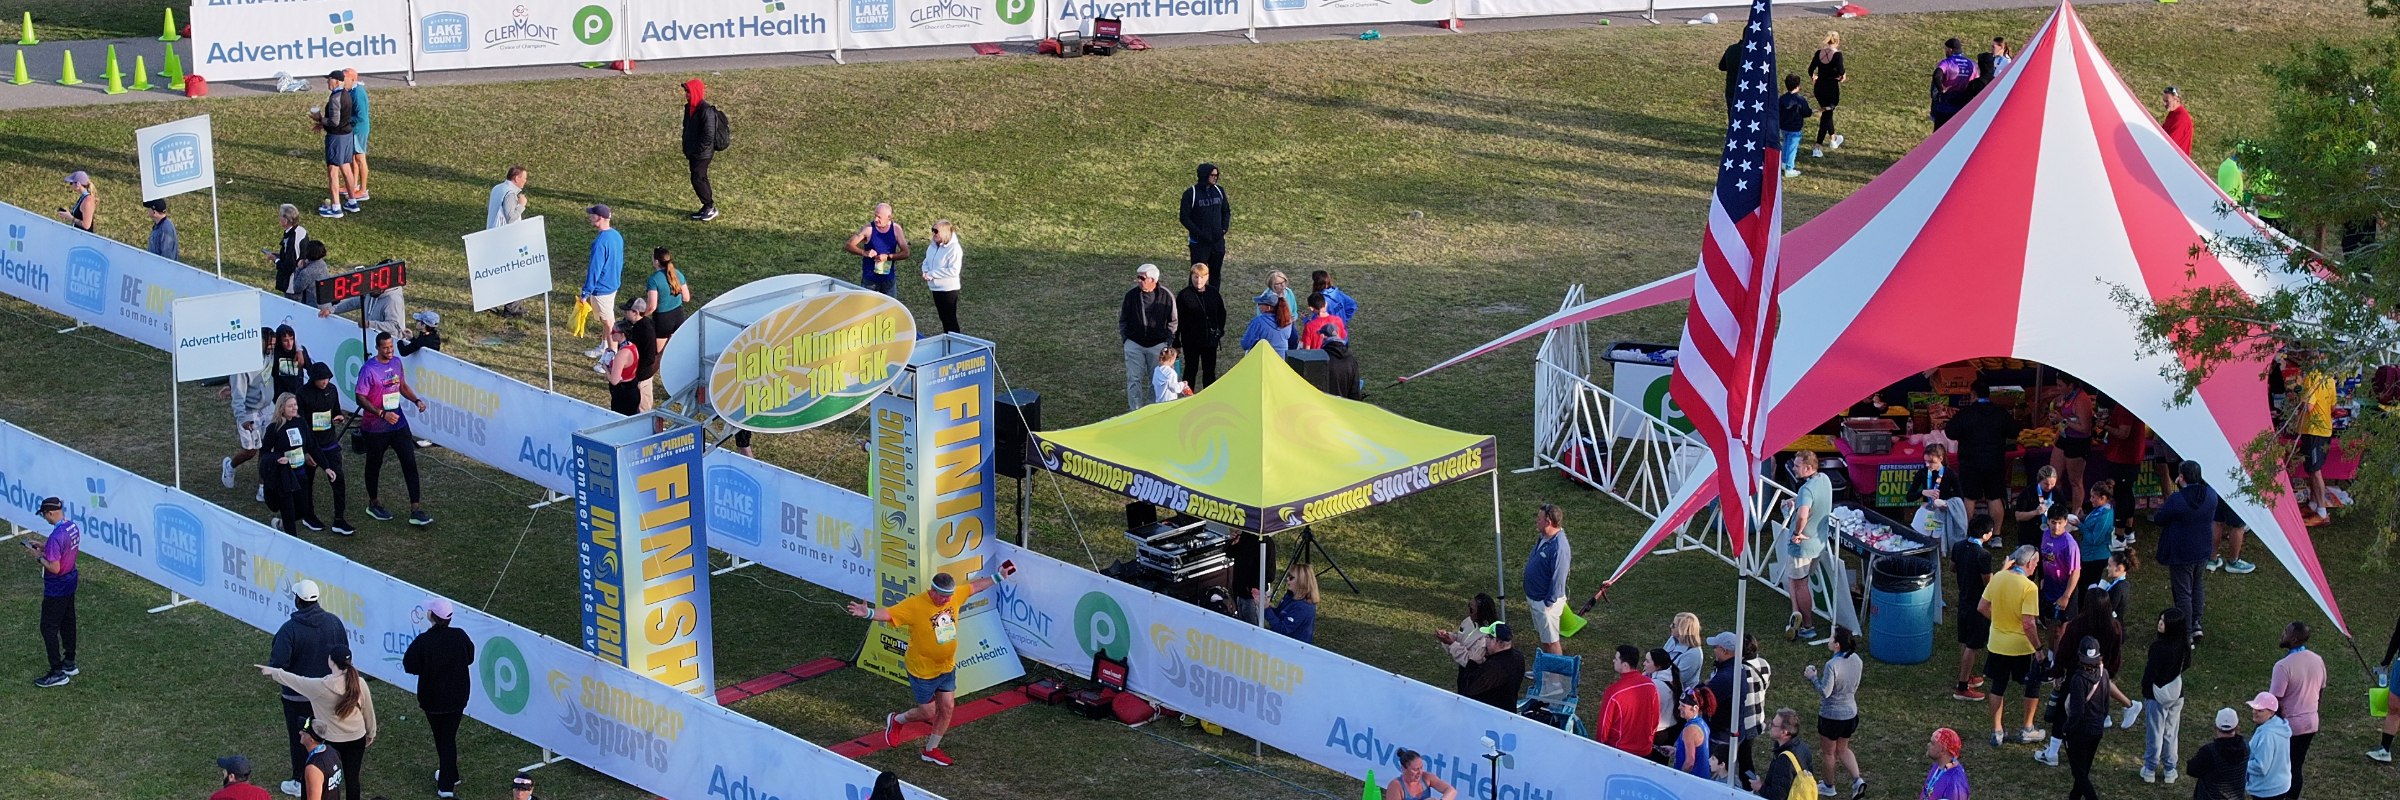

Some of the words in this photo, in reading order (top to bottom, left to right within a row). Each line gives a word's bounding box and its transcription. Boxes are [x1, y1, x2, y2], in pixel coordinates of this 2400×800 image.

[855, 4, 889, 17] LAKE
[855, 13, 889, 24] COUNTY
[910, 0, 982, 24] CLERMONT
[428, 23, 463, 37] LAKE
[428, 35, 463, 45] COUNTY
[484, 17, 559, 44] CLERMONT
[640, 12, 827, 43] AdventHealth
[206, 33, 397, 65] AdventHealth
[158, 146, 194, 167] LAKE
[160, 159, 195, 176] COUNTY
[70, 263, 102, 289] LAKE
[474, 252, 546, 281] AdventHealth
[69, 280, 100, 300] COUNTY
[120, 273, 143, 308] BE
[119, 306, 158, 328] sommer
[179, 327, 259, 349] AdventHealth
[735, 344, 788, 384] Lake
[791, 314, 897, 368] Minneola
[414, 366, 500, 421] sommer
[744, 374, 790, 417] Half
[806, 360, 847, 399] 10K
[418, 399, 487, 448] sports
[575, 444, 589, 531] sommer
[587, 447, 614, 499] BE
[1879, 469, 1917, 483] ATHLE
[713, 484, 754, 516] LAKE
[1878, 482, 1909, 496] ONL
[713, 504, 754, 529] COUNTY
[781, 501, 809, 541] BE
[161, 525, 198, 555] LAKE
[781, 538, 834, 564] sommer
[161, 545, 198, 568] COUNTY
[221, 541, 247, 582] BE
[842, 559, 876, 578] spor
[581, 542, 594, 614] sports
[637, 462, 700, 687] FINISH
[223, 579, 271, 607] sommer
[996, 583, 1053, 637] MONT
[955, 645, 1008, 670] ventHealth
[1185, 626, 1304, 696] sommer
[580, 674, 685, 743] sommer
[1188, 663, 1283, 726] sports
[584, 711, 669, 774] sports
